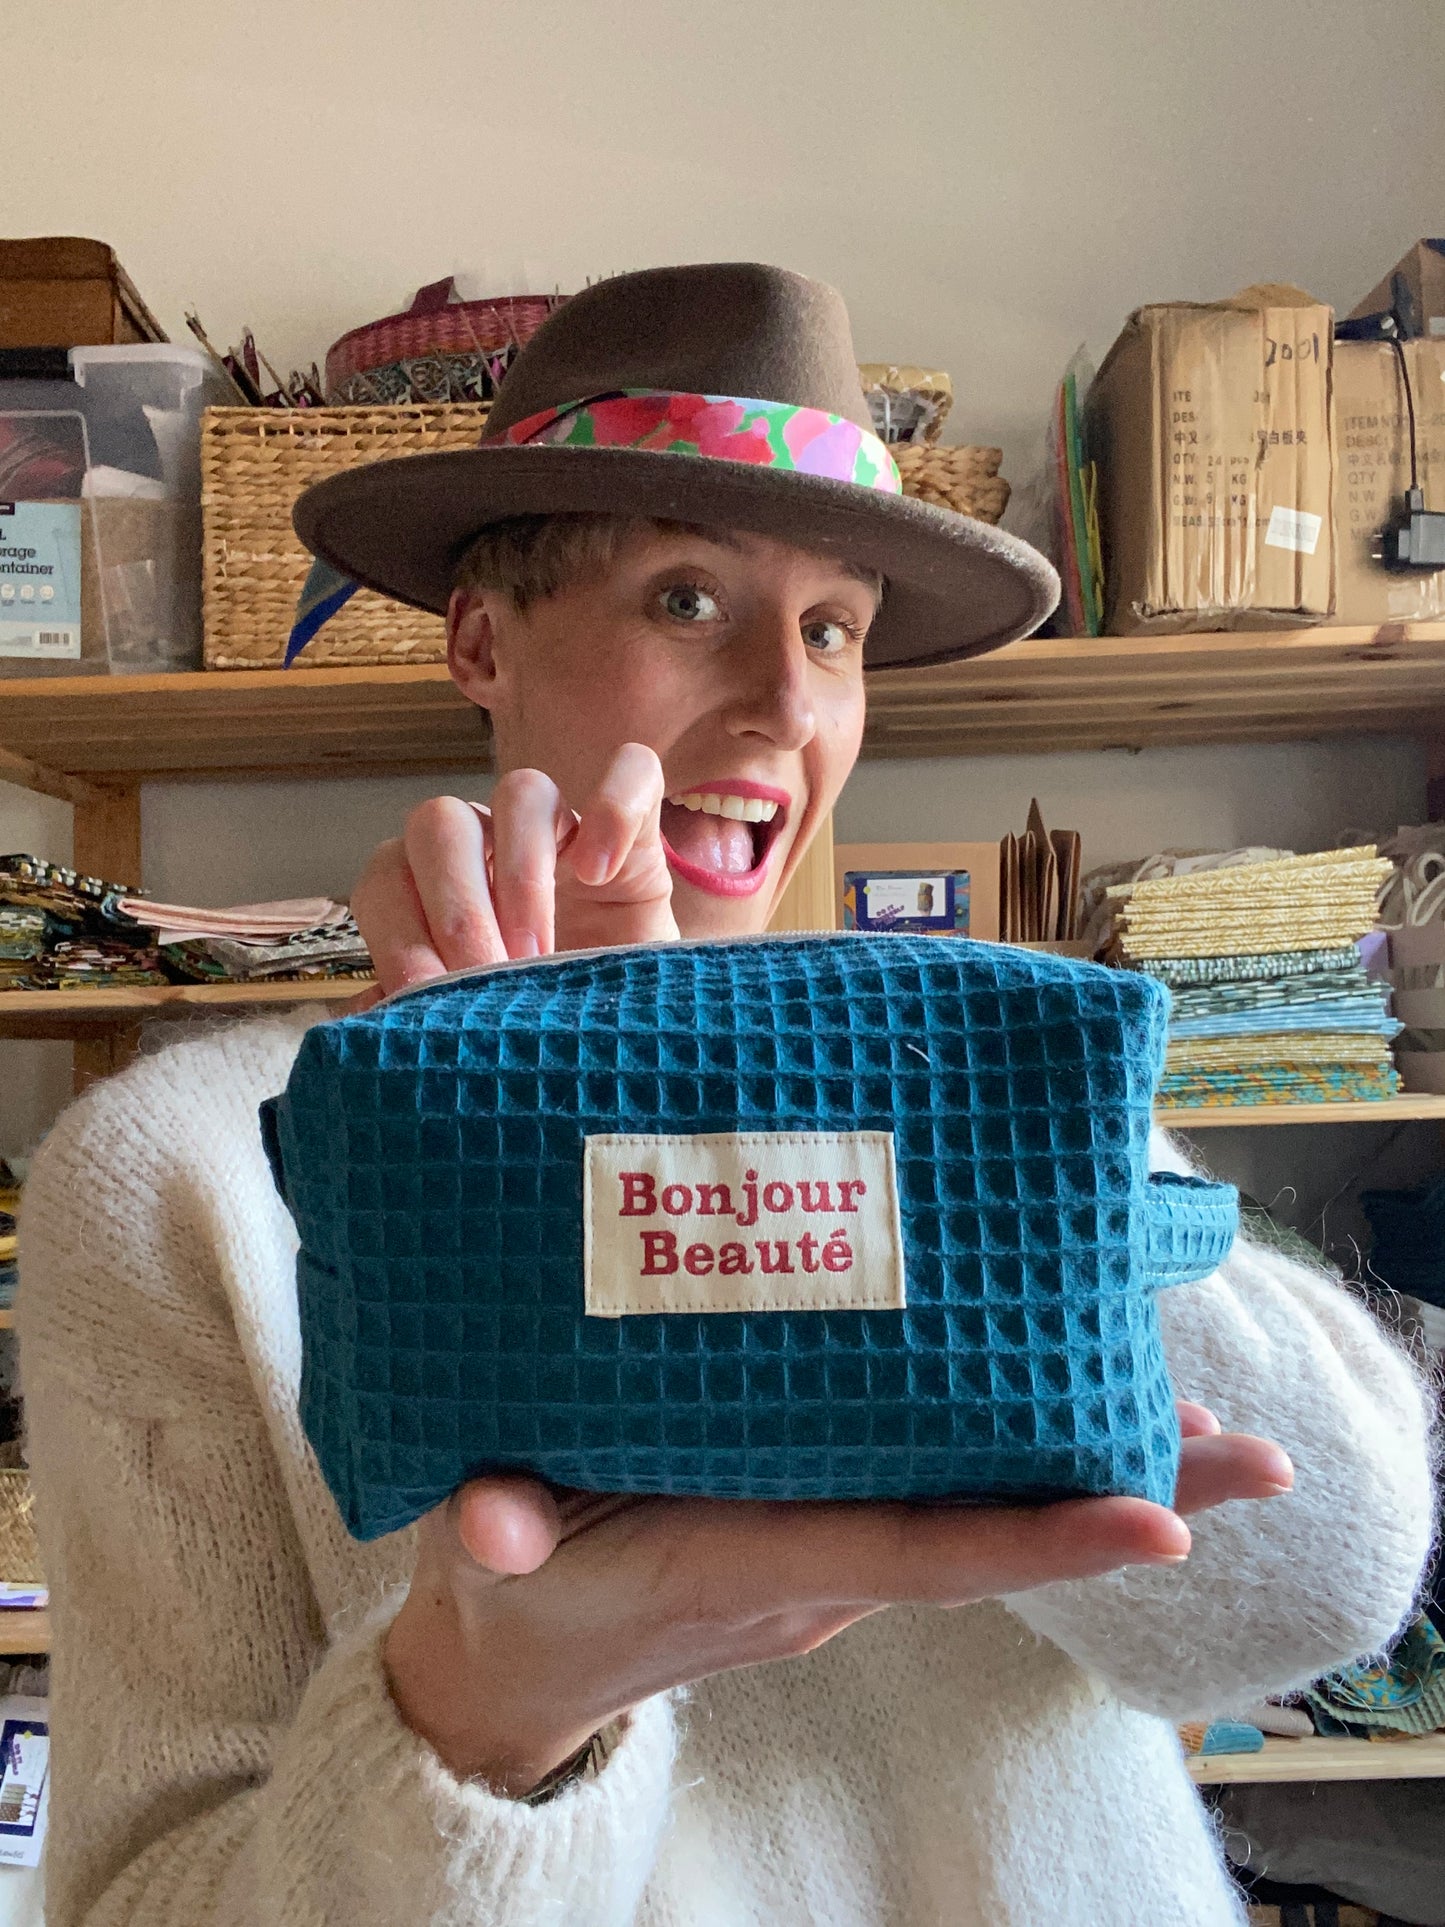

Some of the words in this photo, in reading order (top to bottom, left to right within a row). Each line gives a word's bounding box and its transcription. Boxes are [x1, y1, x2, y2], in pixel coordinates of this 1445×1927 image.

[0, 547, 37, 561] rage
[0, 561, 54, 575] ntainer
[618, 1168, 867, 1227] Bonjour
[639, 1228, 853, 1277] Beauté
